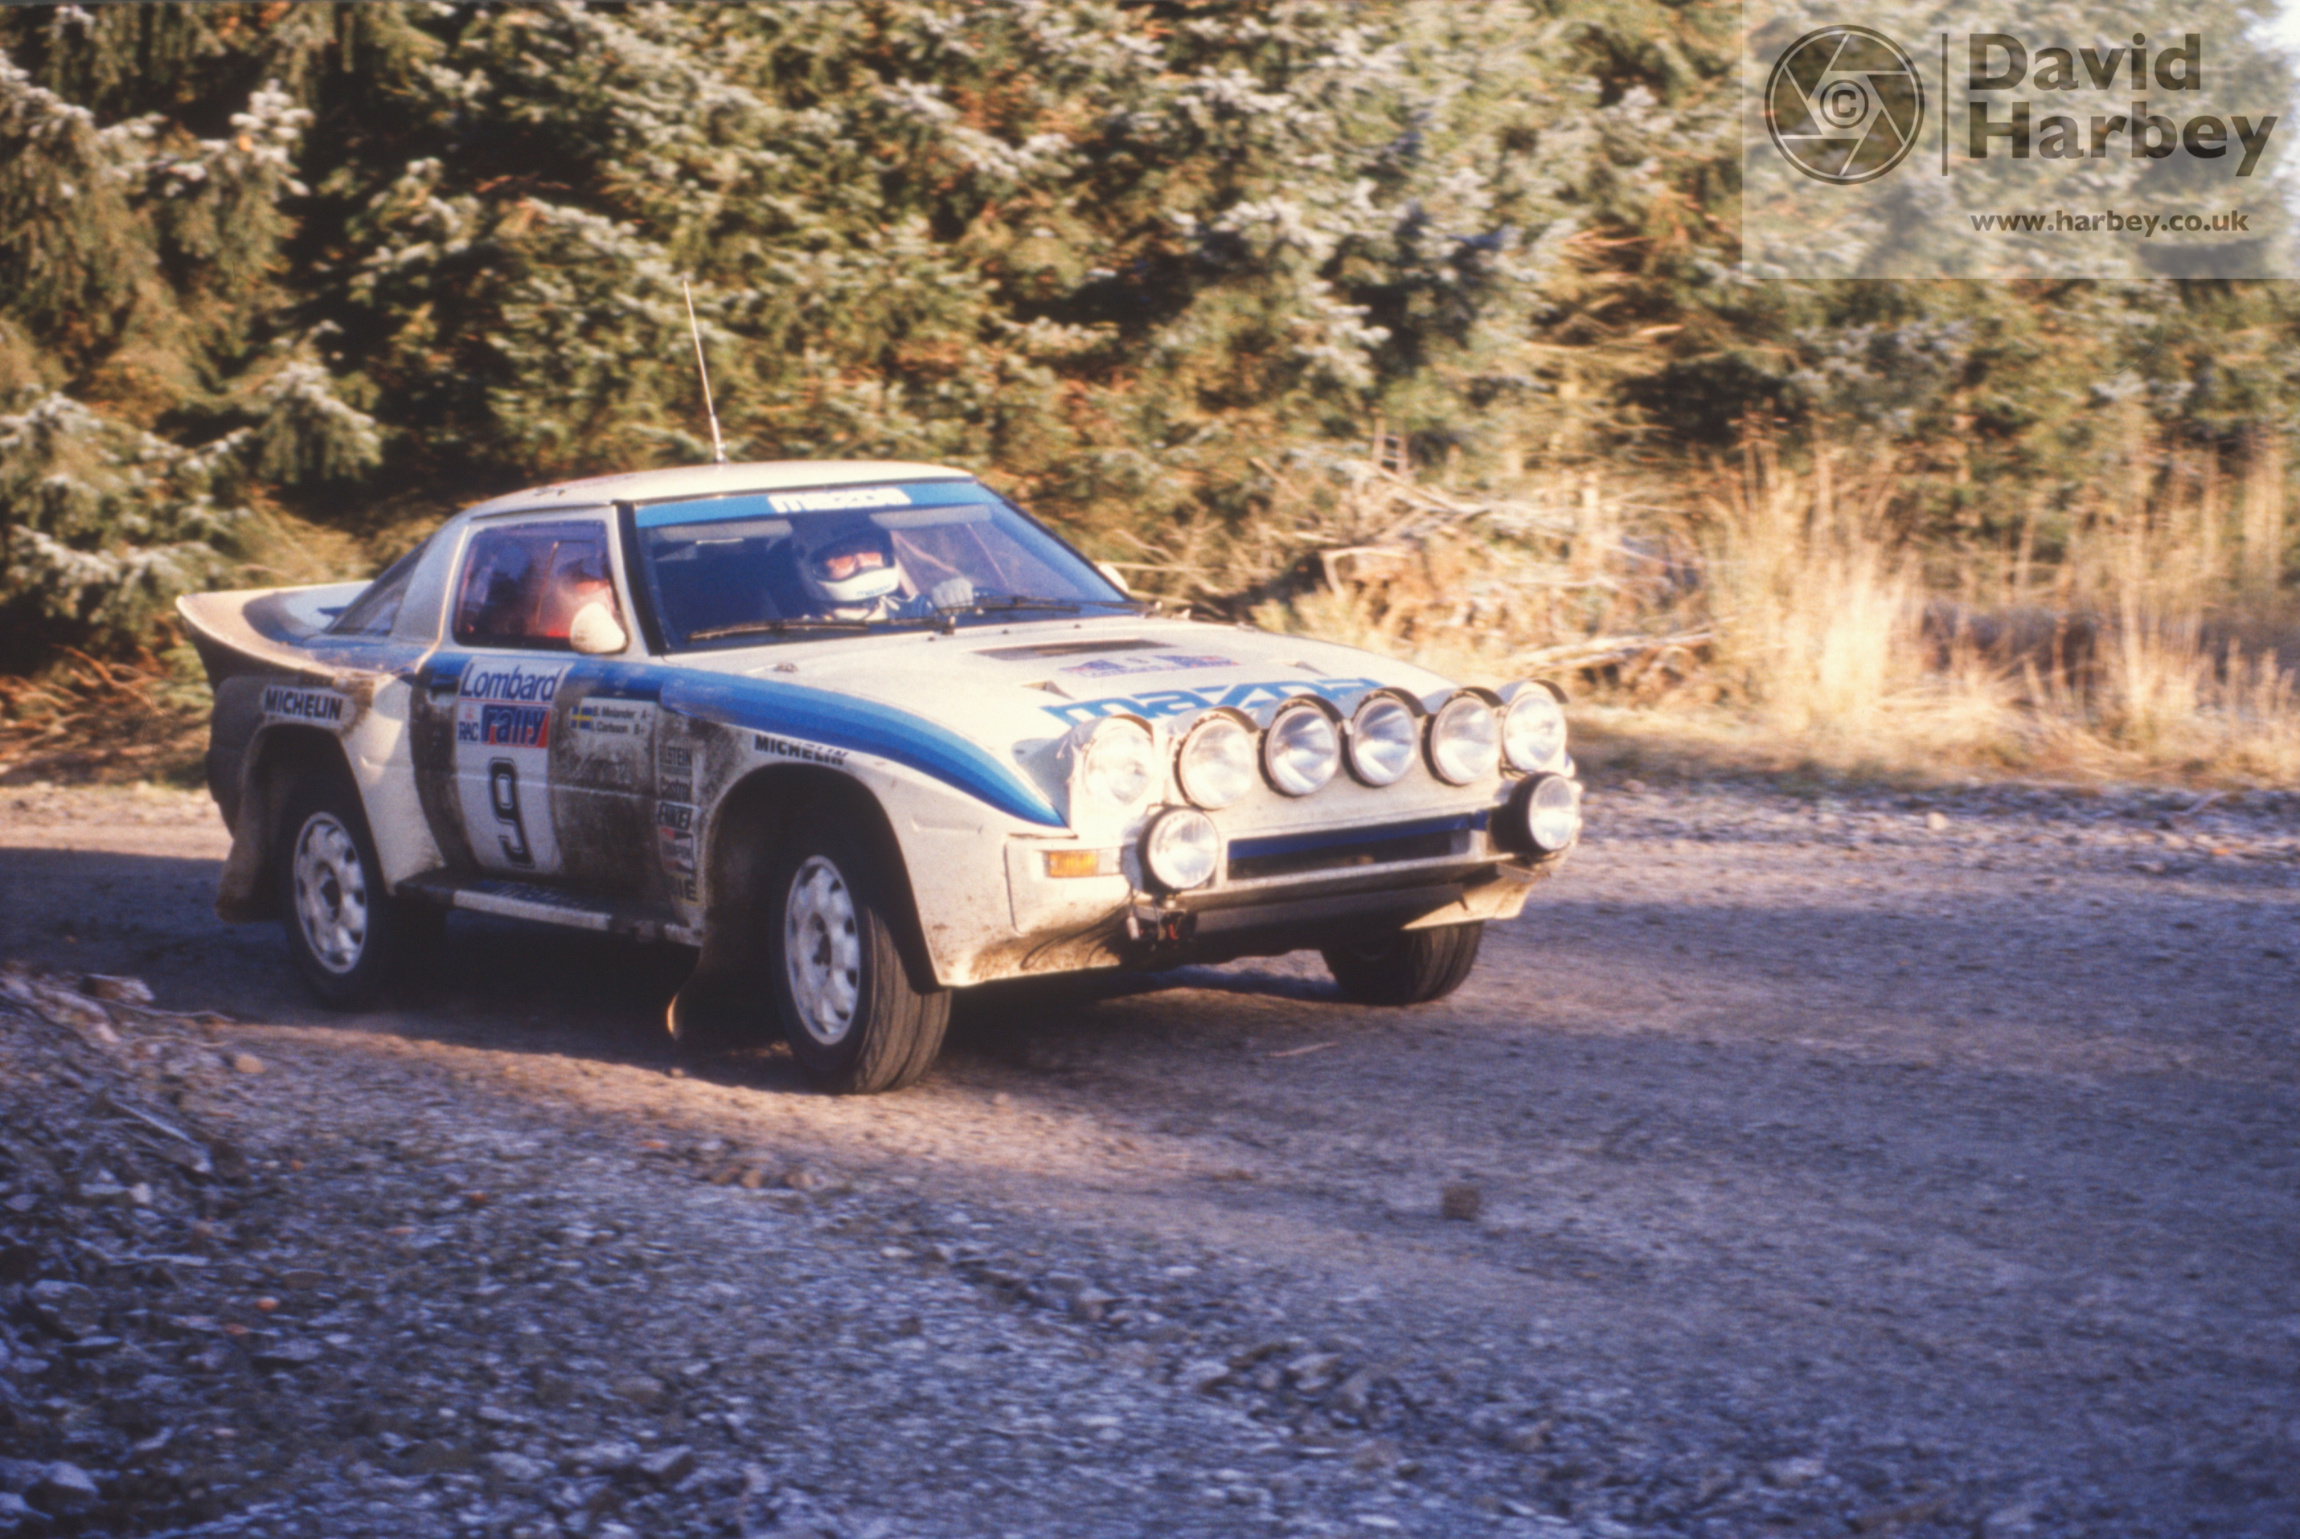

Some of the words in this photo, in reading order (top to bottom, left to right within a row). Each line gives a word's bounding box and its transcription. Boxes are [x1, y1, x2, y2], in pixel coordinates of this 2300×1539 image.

[460, 662, 564, 702] Lombard
[264, 687, 344, 720] MICHELIN
[458, 721, 480, 742] RAC
[482, 706, 547, 747] rally
[754, 734, 849, 766] MICHELIN
[488, 757, 536, 869] 9
